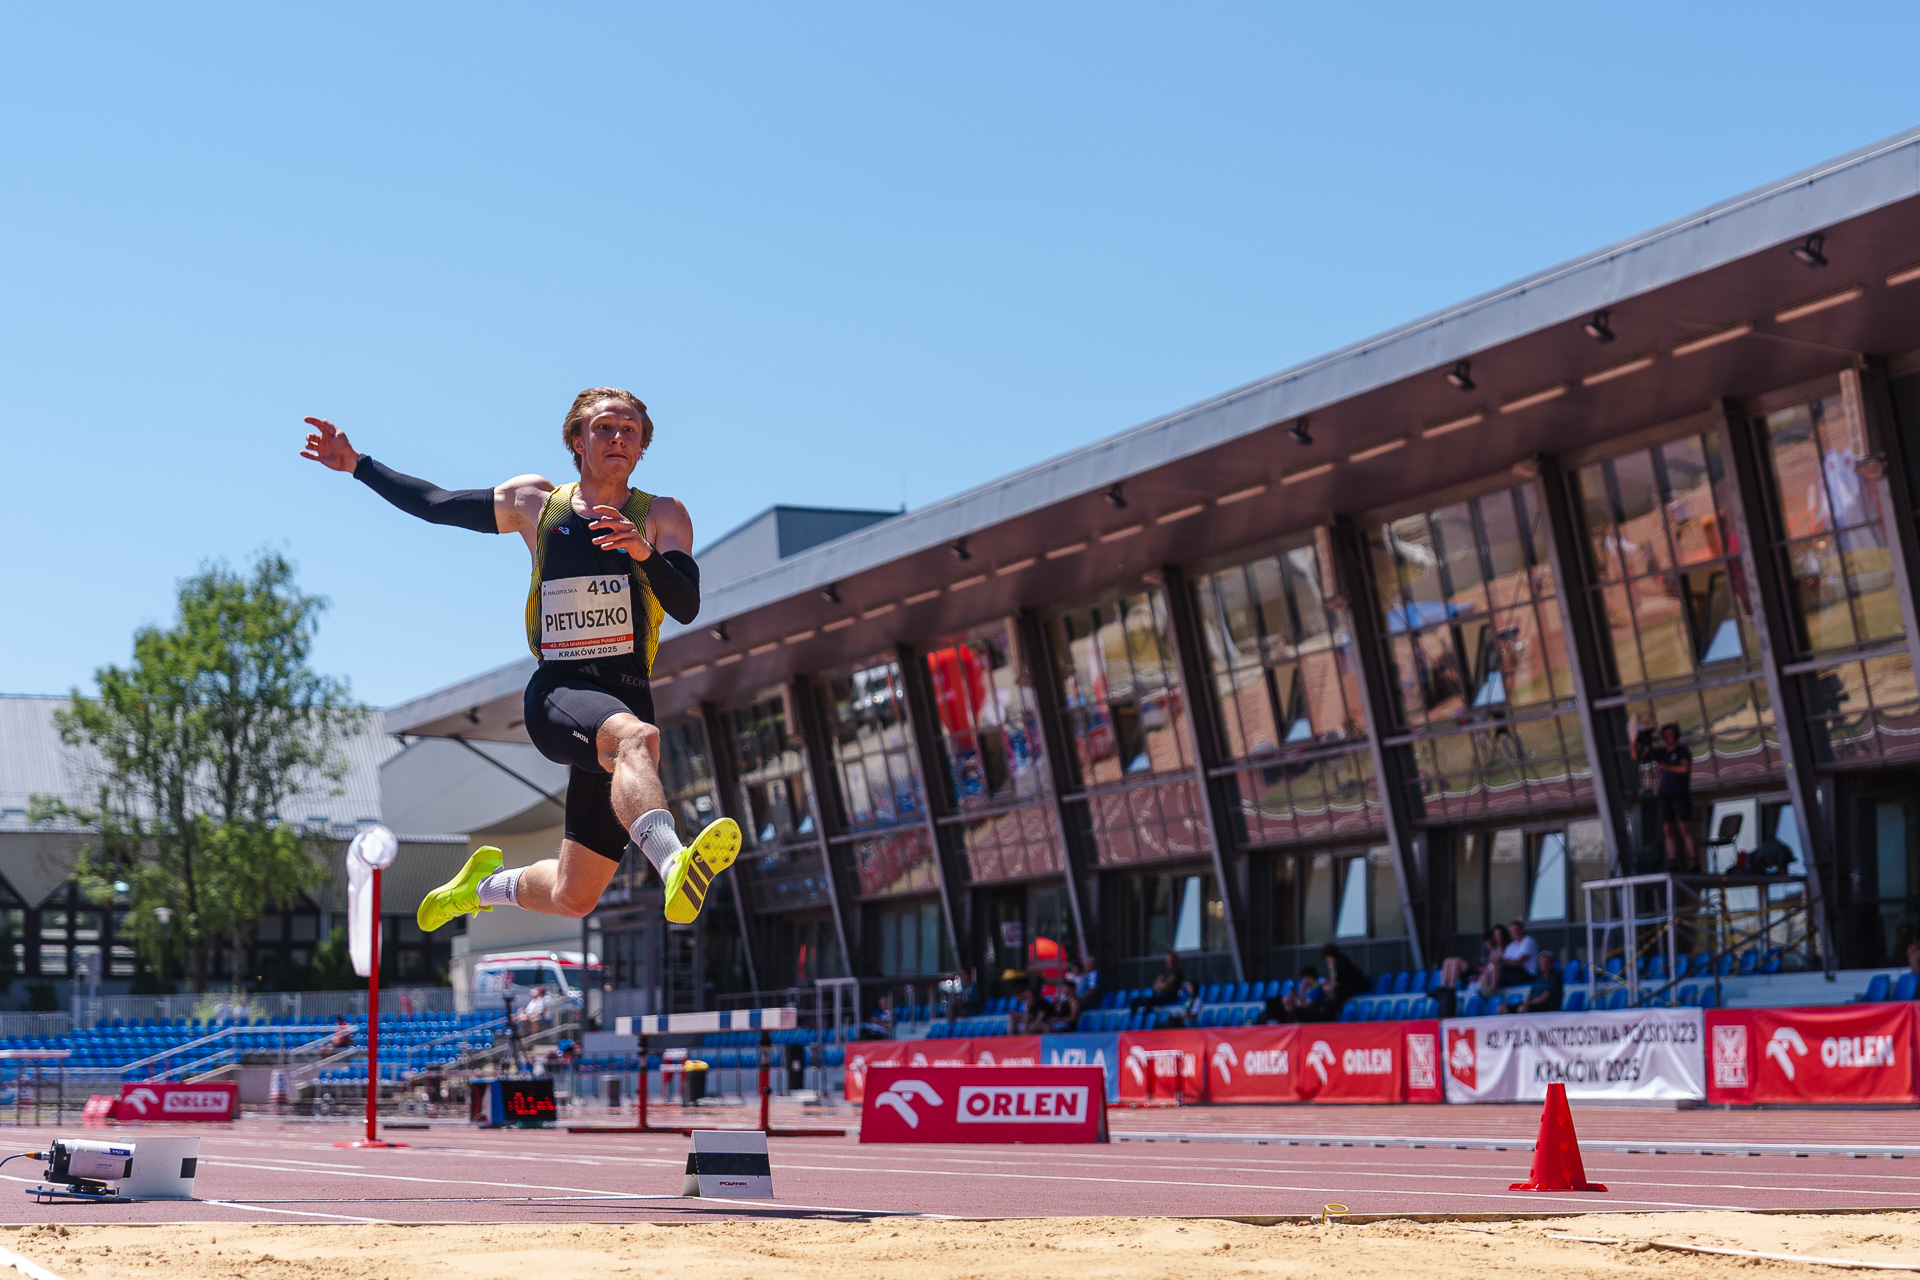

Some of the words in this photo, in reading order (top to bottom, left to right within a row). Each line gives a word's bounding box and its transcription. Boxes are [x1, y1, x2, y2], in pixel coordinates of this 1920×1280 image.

[587, 580, 622, 595] 410
[545, 606, 628, 632] PIETUSZKO
[558, 647, 596, 658] KRAKÓW
[597, 646, 618, 654] 2025
[1536, 1024, 1620, 1048] MISTRZOSTWA
[1624, 1021, 1669, 1044] POLSKI
[1243, 1049, 1290, 1076] ORLEN
[1342, 1048, 1393, 1075] ORLEN
[1820, 1035, 1896, 1069] ORLEN
[1534, 1053, 1600, 1083] KRAKÓW
[1605, 1056, 1642, 1082] 2025
[169, 1093, 224, 1109] ORLEN
[966, 1092, 1079, 1117] ORLEN
